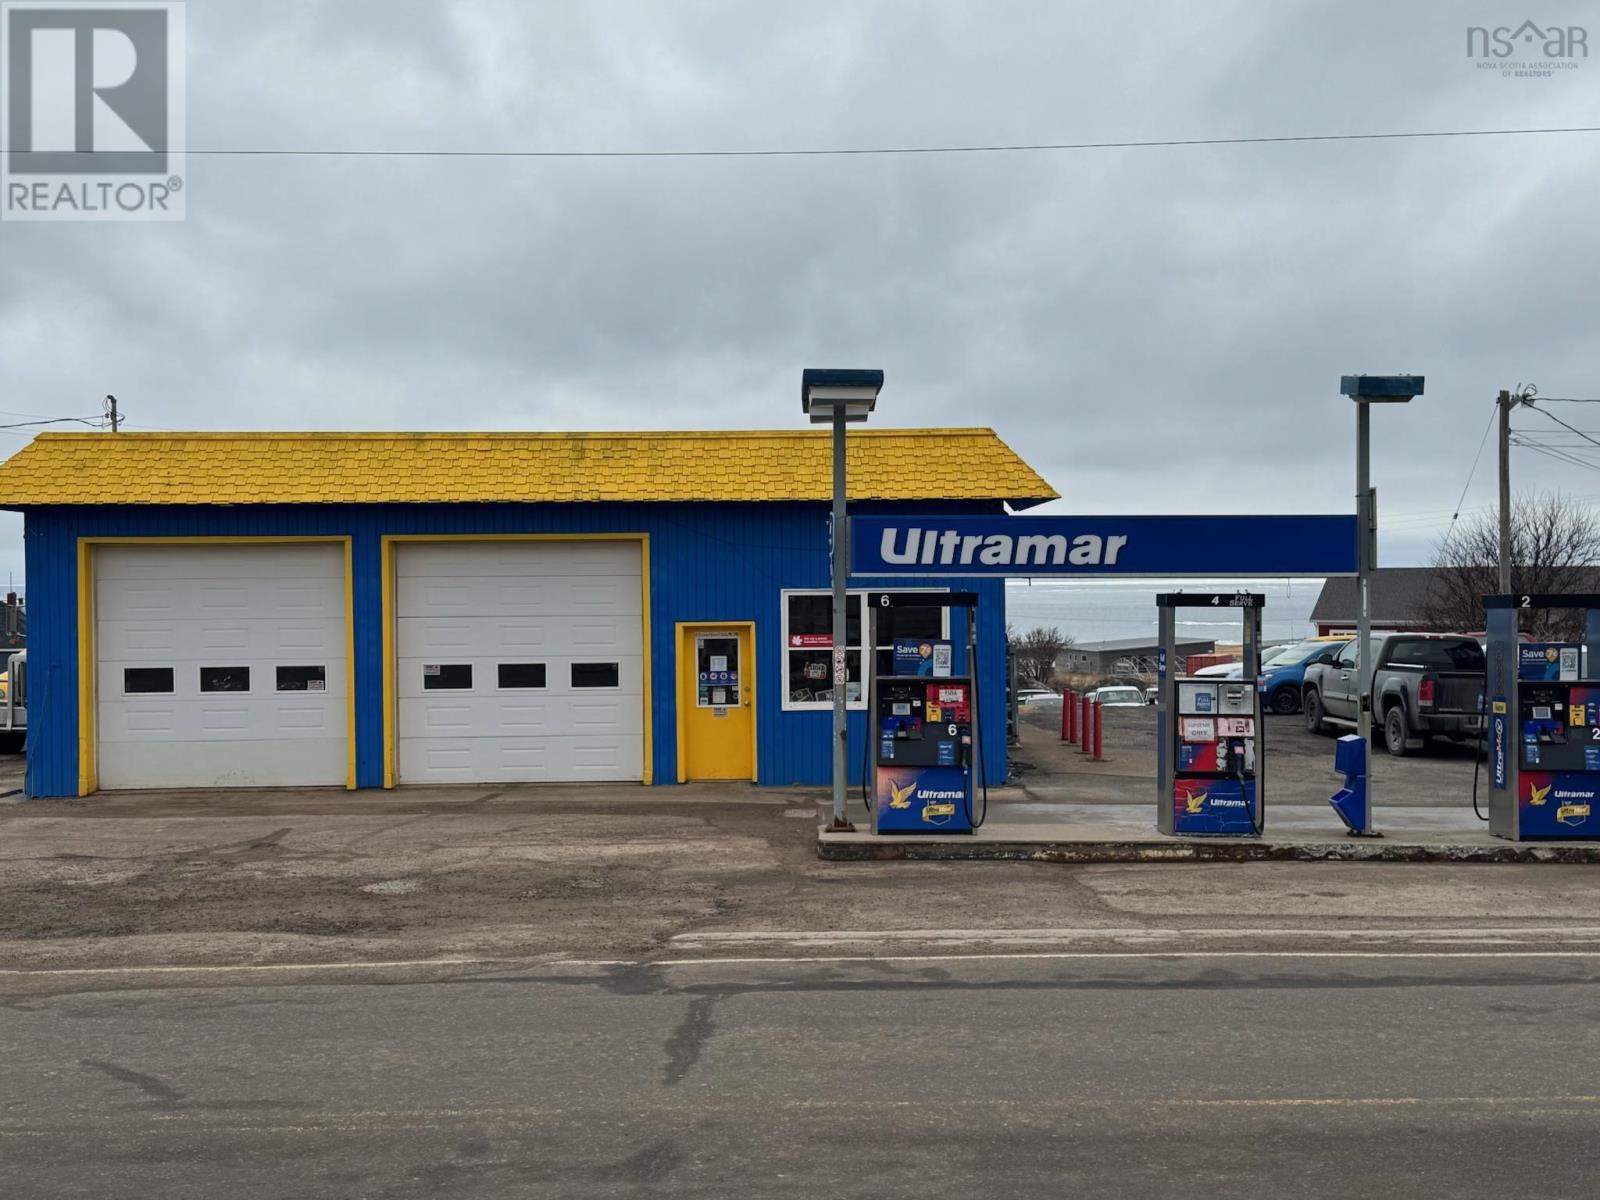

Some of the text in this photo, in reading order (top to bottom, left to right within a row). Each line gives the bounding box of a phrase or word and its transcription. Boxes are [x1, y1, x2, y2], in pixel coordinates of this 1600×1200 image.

[880, 527, 1127, 565] Ultramar
[880, 594, 890, 607] 6
[1211, 595, 1220, 606] 4
[1521, 595, 1531, 608] 2
[896, 645, 918, 654] Save
[1521, 649, 1545, 658] Save
[948, 724, 958, 736] 6
[1592, 727, 1600, 740] 2
[1554, 790, 1595, 798] Ultramar
[1210, 798, 1250, 807] Ultrama
